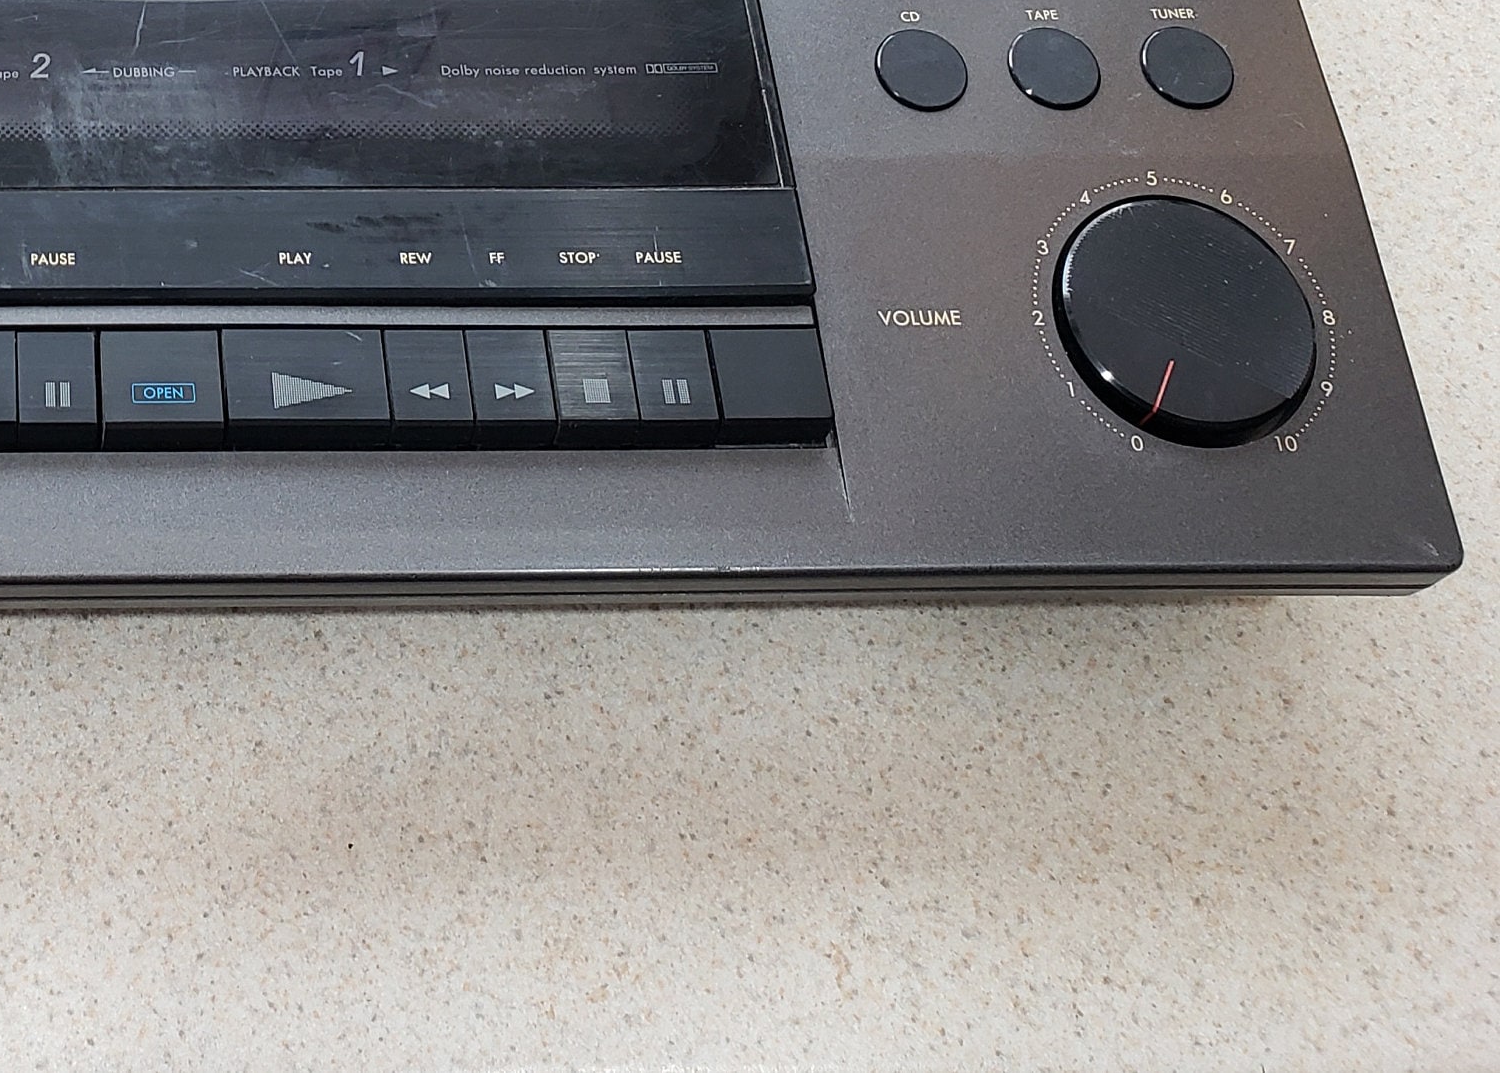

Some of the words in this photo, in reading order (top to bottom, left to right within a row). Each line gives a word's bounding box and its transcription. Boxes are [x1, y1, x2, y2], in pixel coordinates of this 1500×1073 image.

[900, 10, 920, 23] CD
[1025, 9, 1059, 21] TAPE
[1150, 7, 1195, 20] TUNER
[29, 53, 52, 80] 2
[113, 65, 175, 79] DUBBING
[232, 65, 300, 78] PLAYBACK
[310, 65, 343, 79] Tape
[348, 51, 365, 76] 1
[441, 64, 480, 78] Dolby
[485, 64, 520, 76] noise
[524, 63, 586, 76] reduction
[593, 64, 637, 77] system
[1146, 171, 1157, 187] 5
[1079, 190, 1091, 205] 4
[1220, 189, 1232, 205] 6
[1037, 239, 1049, 255] 3
[1283, 239, 1296, 255] 7
[30, 252, 76, 267] PAUSE
[278, 251, 313, 265] PLAY
[399, 251, 432, 265] REW
[489, 251, 505, 265] FF
[559, 250, 594, 265] STOP
[635, 250, 682, 265] PAUSE
[877, 309, 962, 326] VOLUME
[1032, 309, 1045, 326] 2
[1323, 309, 1336, 326] 8
[143, 386, 185, 401] OPEN
[1066, 381, 1075, 397] 1
[1321, 380, 1334, 397] 9
[1130, 435, 1144, 452] 0
[1274, 435, 1298, 452] 10
